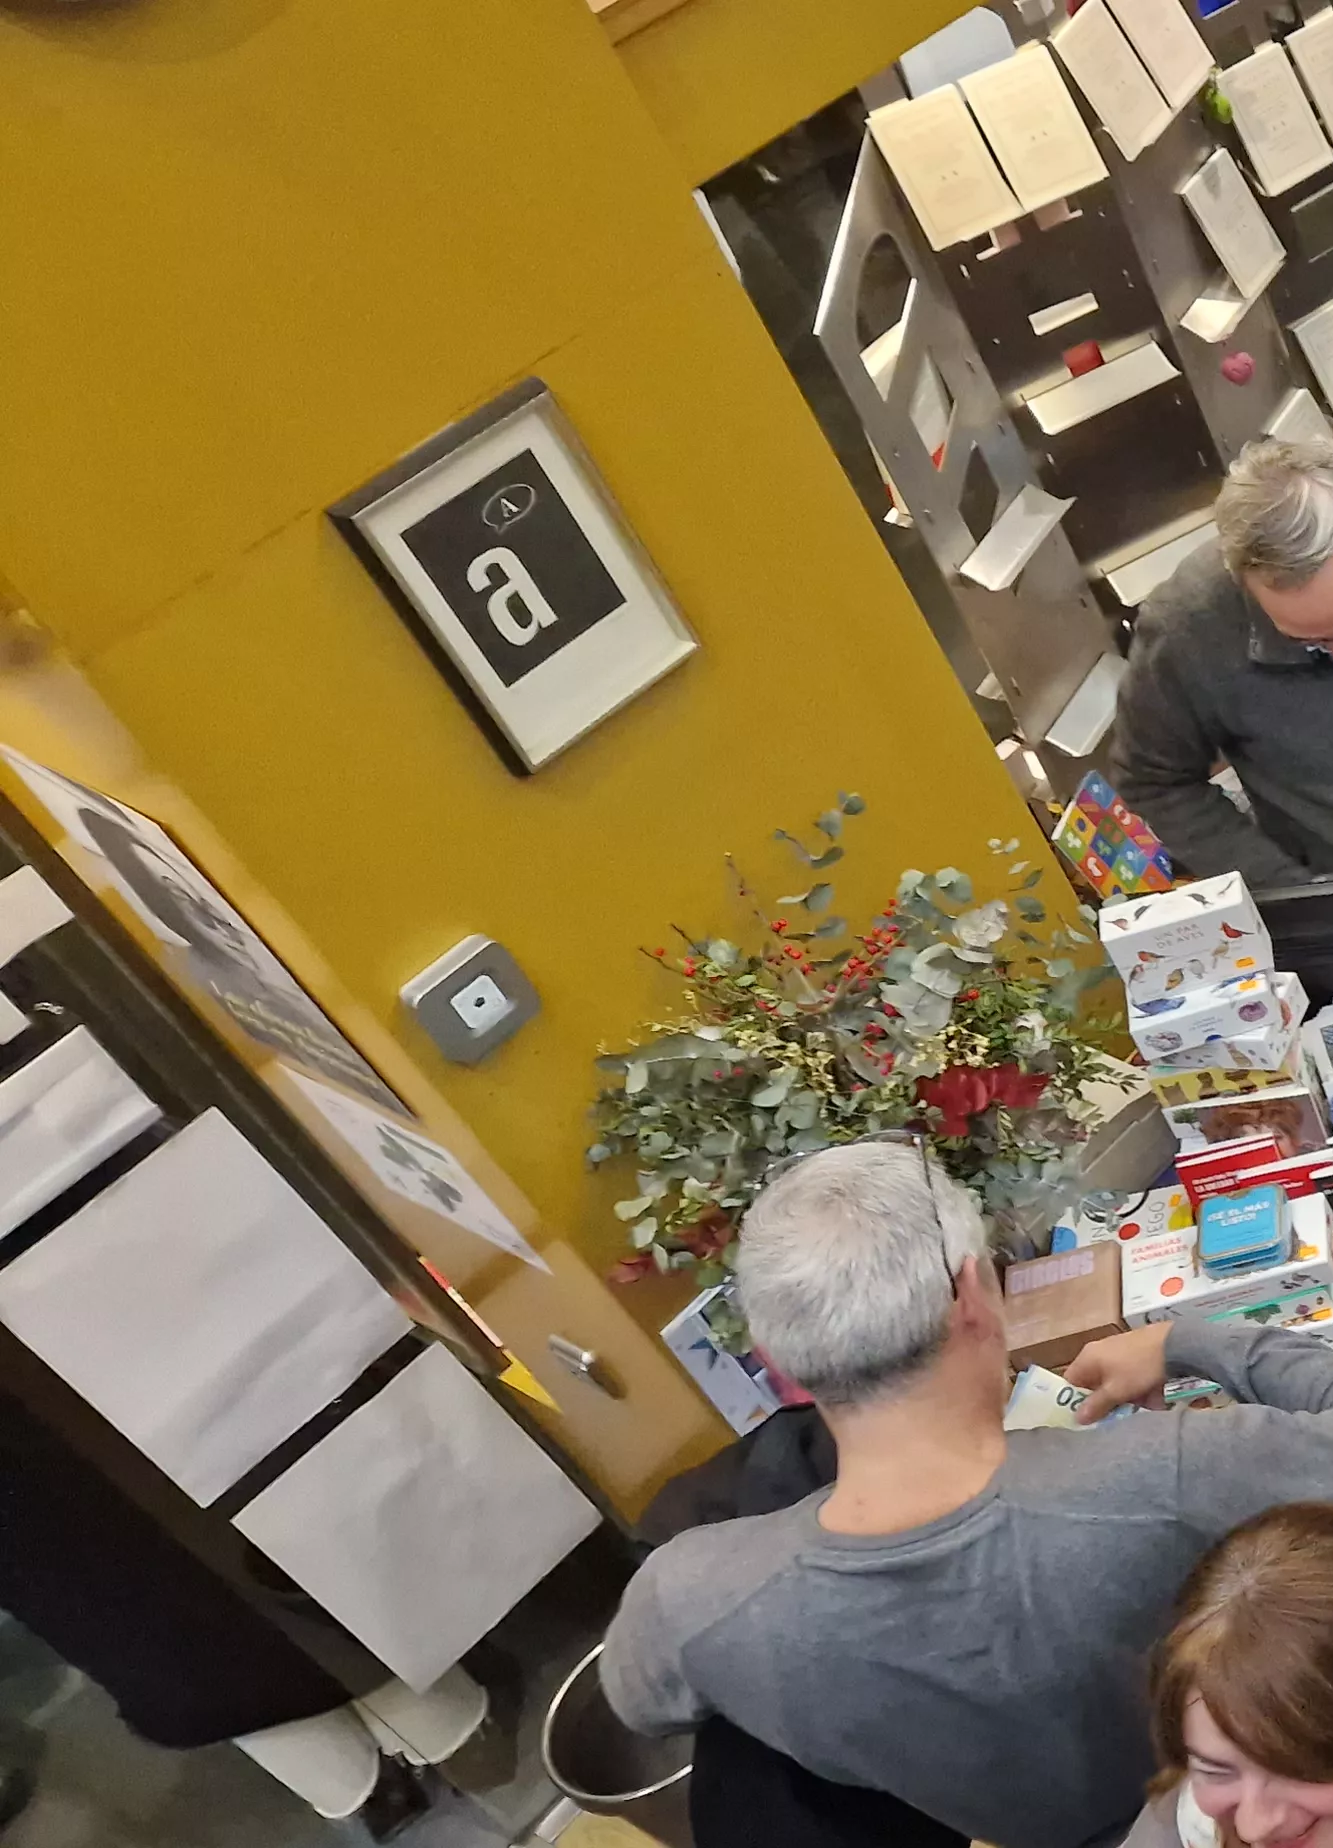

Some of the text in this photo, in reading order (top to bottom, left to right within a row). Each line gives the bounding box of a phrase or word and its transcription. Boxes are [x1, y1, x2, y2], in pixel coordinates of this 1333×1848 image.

[466, 546, 559, 646] a
[1176, 923, 1199, 936] PAR
[1177, 931, 1205, 944] AVES
